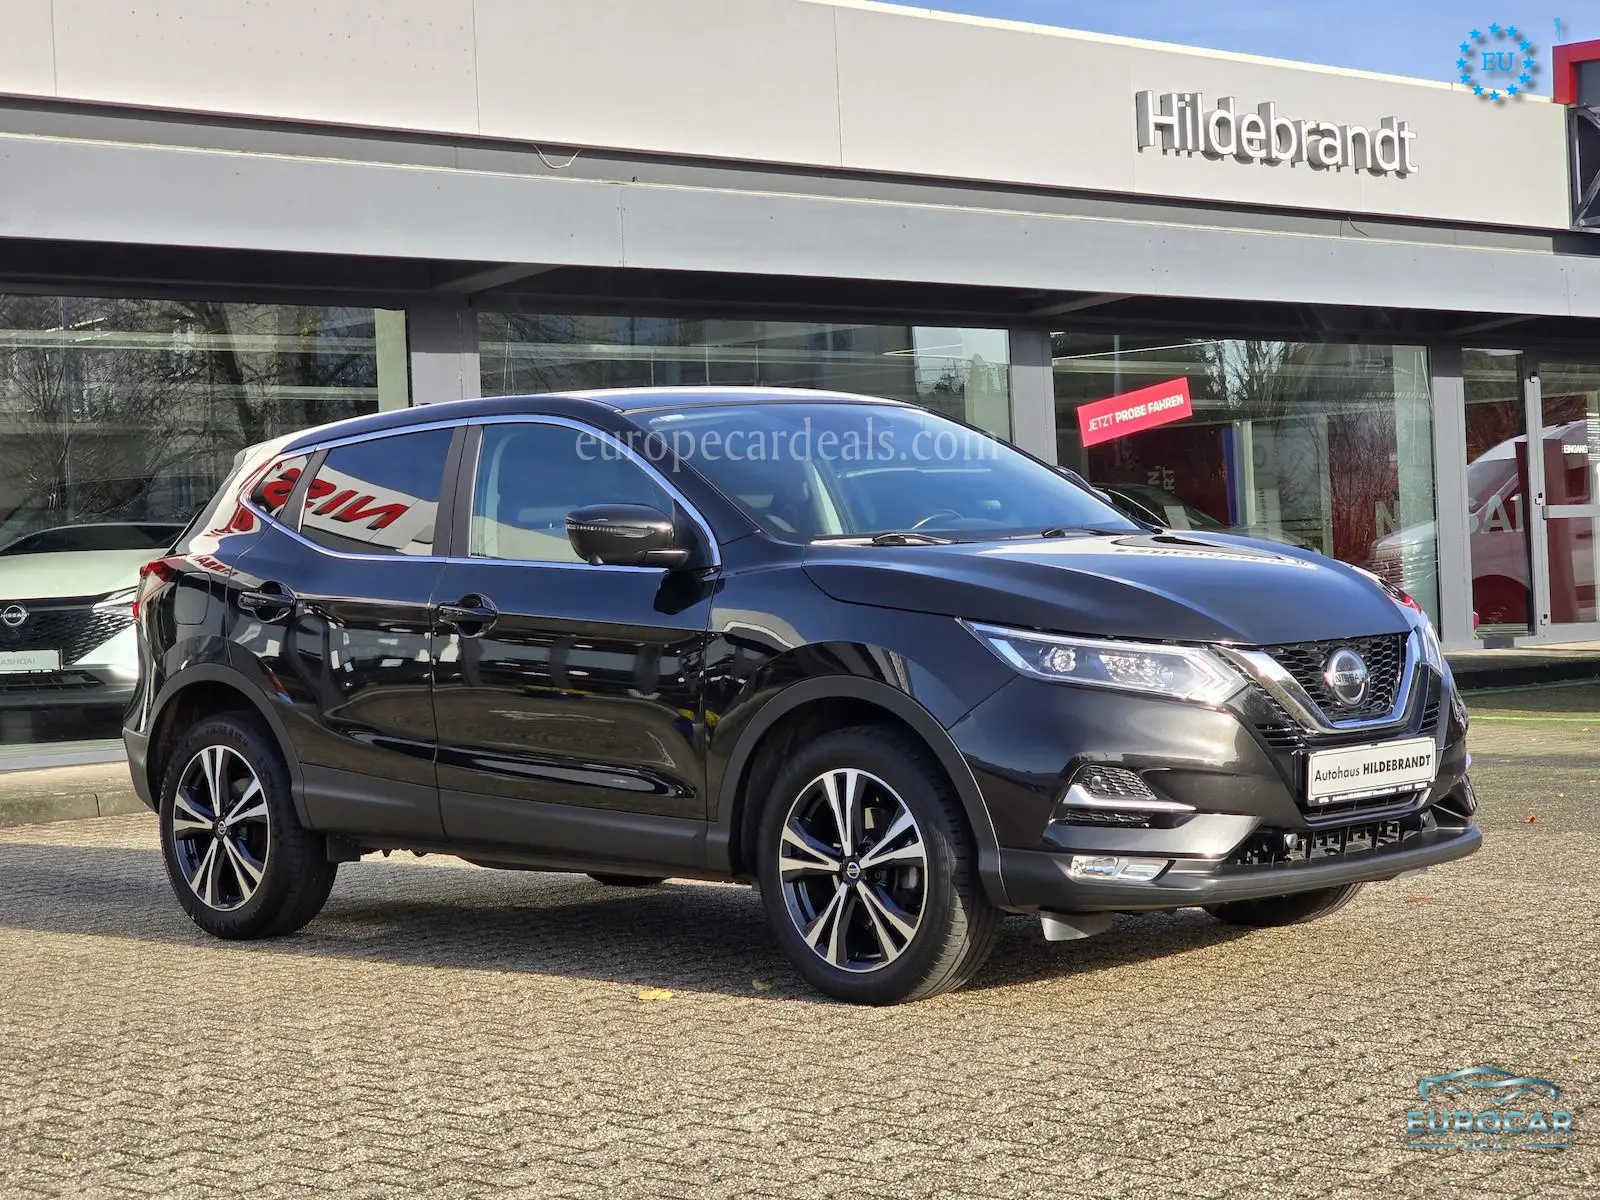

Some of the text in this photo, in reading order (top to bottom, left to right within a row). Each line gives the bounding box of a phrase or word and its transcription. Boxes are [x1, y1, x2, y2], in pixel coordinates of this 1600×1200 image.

[1137, 90, 1418, 177] Hildebrandt
[1088, 393, 1185, 432] JETZT PROBE FAHREN
[1563, 444, 1588, 454] EINGANG
[1314, 754, 1431, 782] Autohaus HILDEBRANDT
